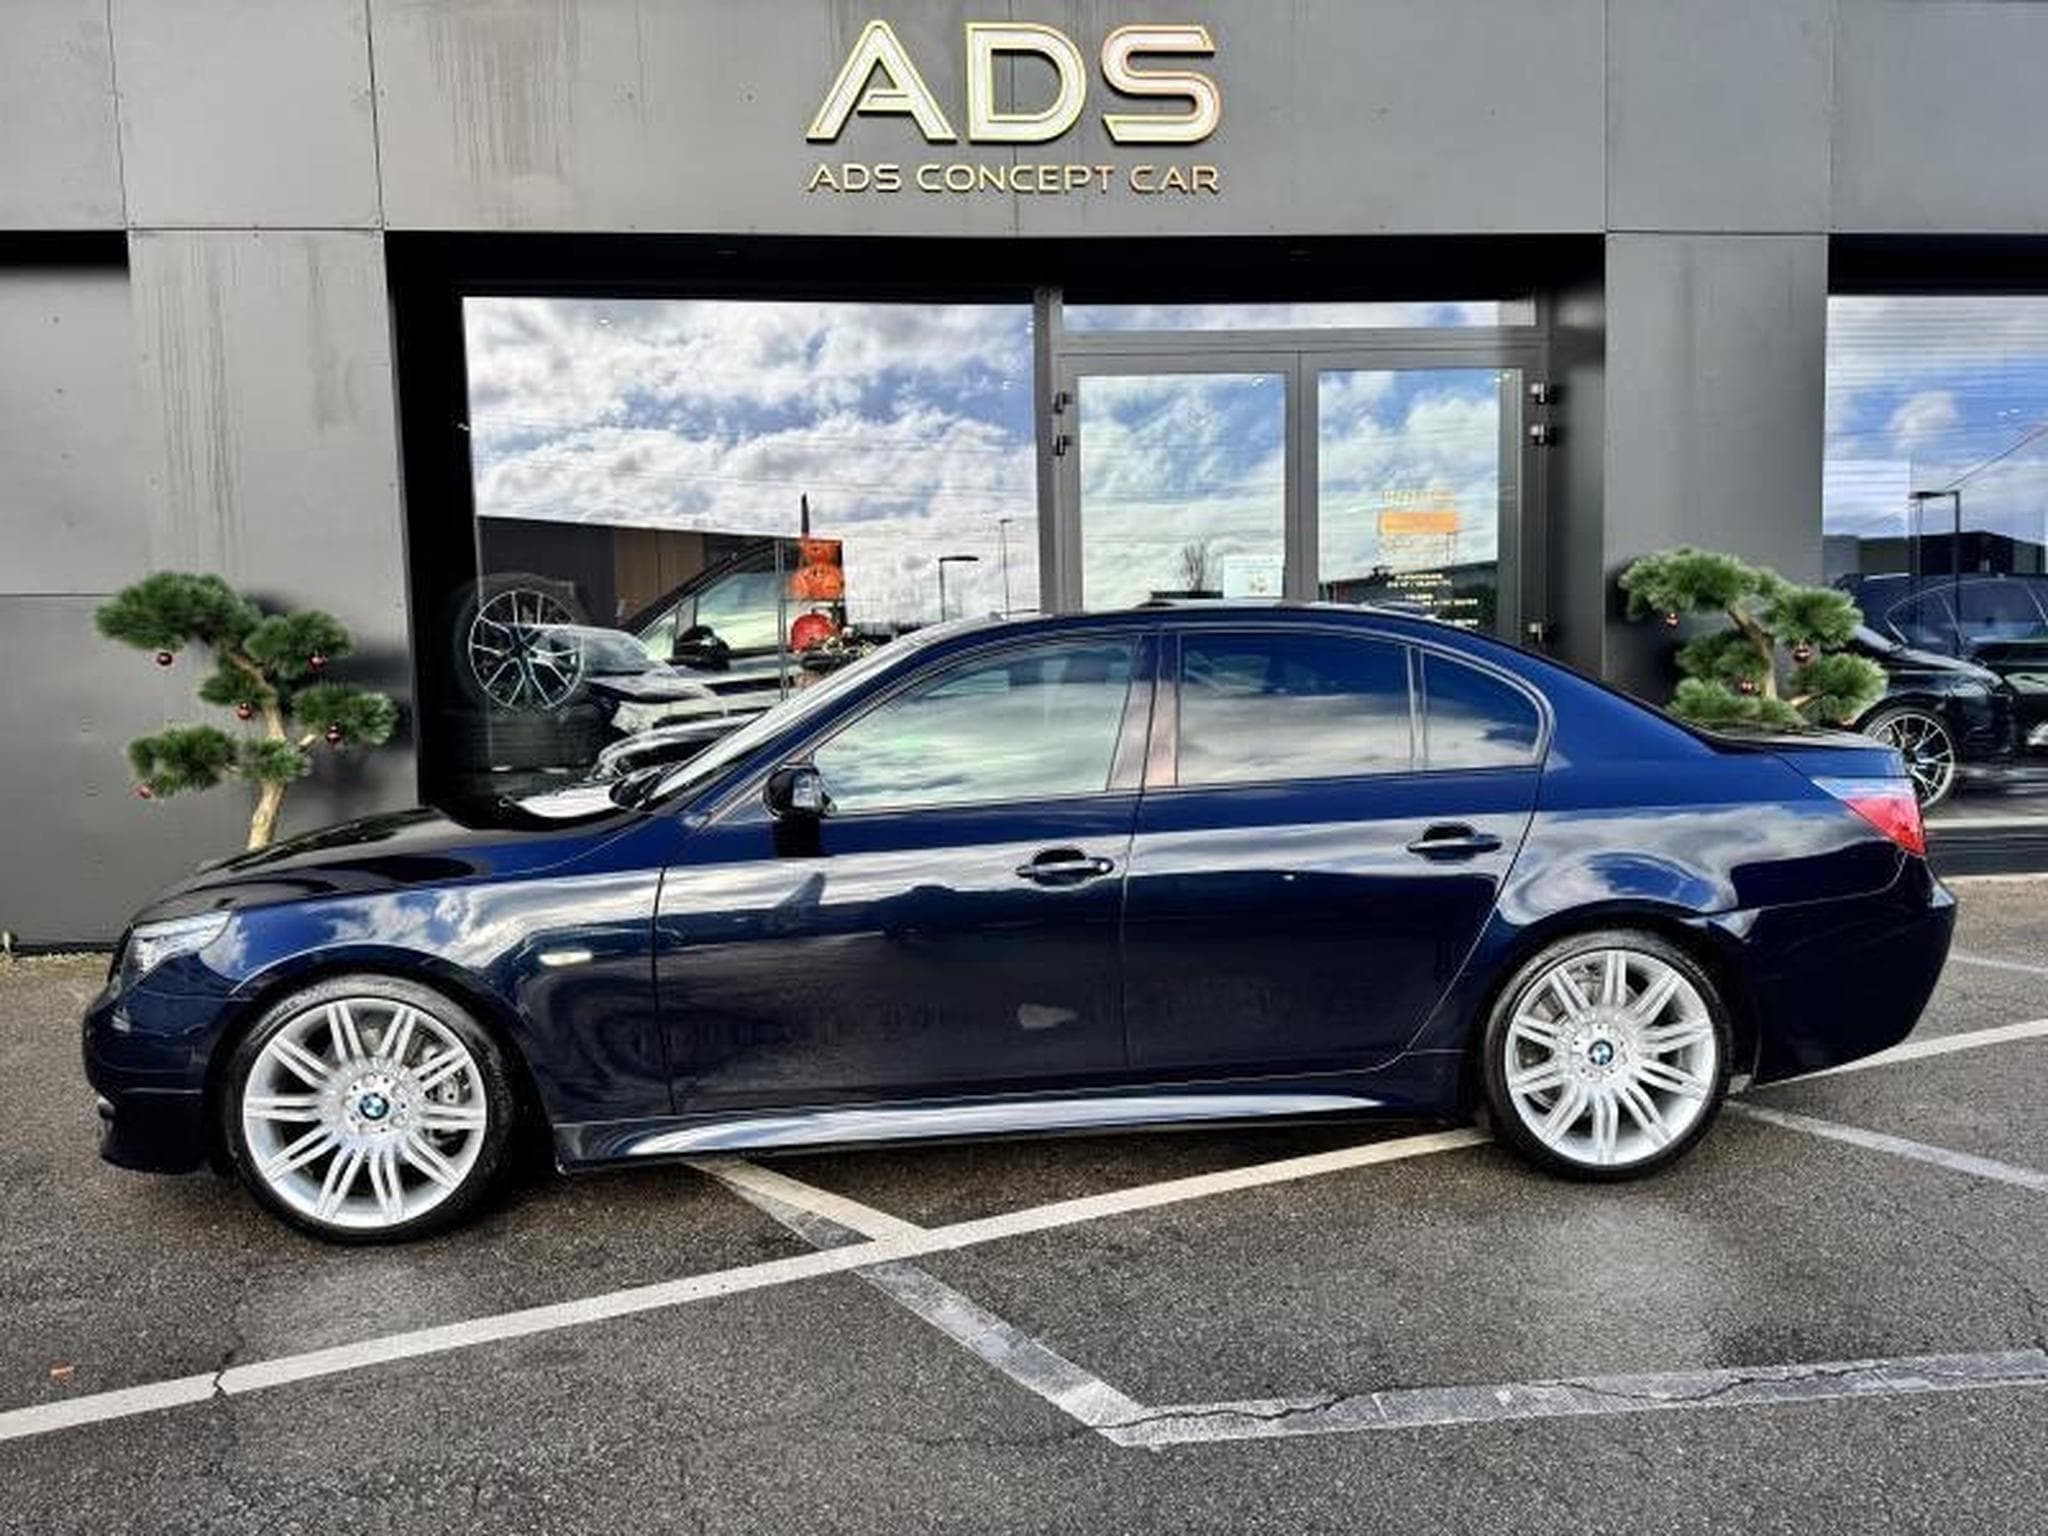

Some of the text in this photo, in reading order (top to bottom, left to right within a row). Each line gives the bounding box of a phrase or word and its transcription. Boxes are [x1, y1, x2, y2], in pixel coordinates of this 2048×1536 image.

[807, 19, 1222, 145] ADS
[808, 163, 1220, 194] ADS CONCEPT CAR
